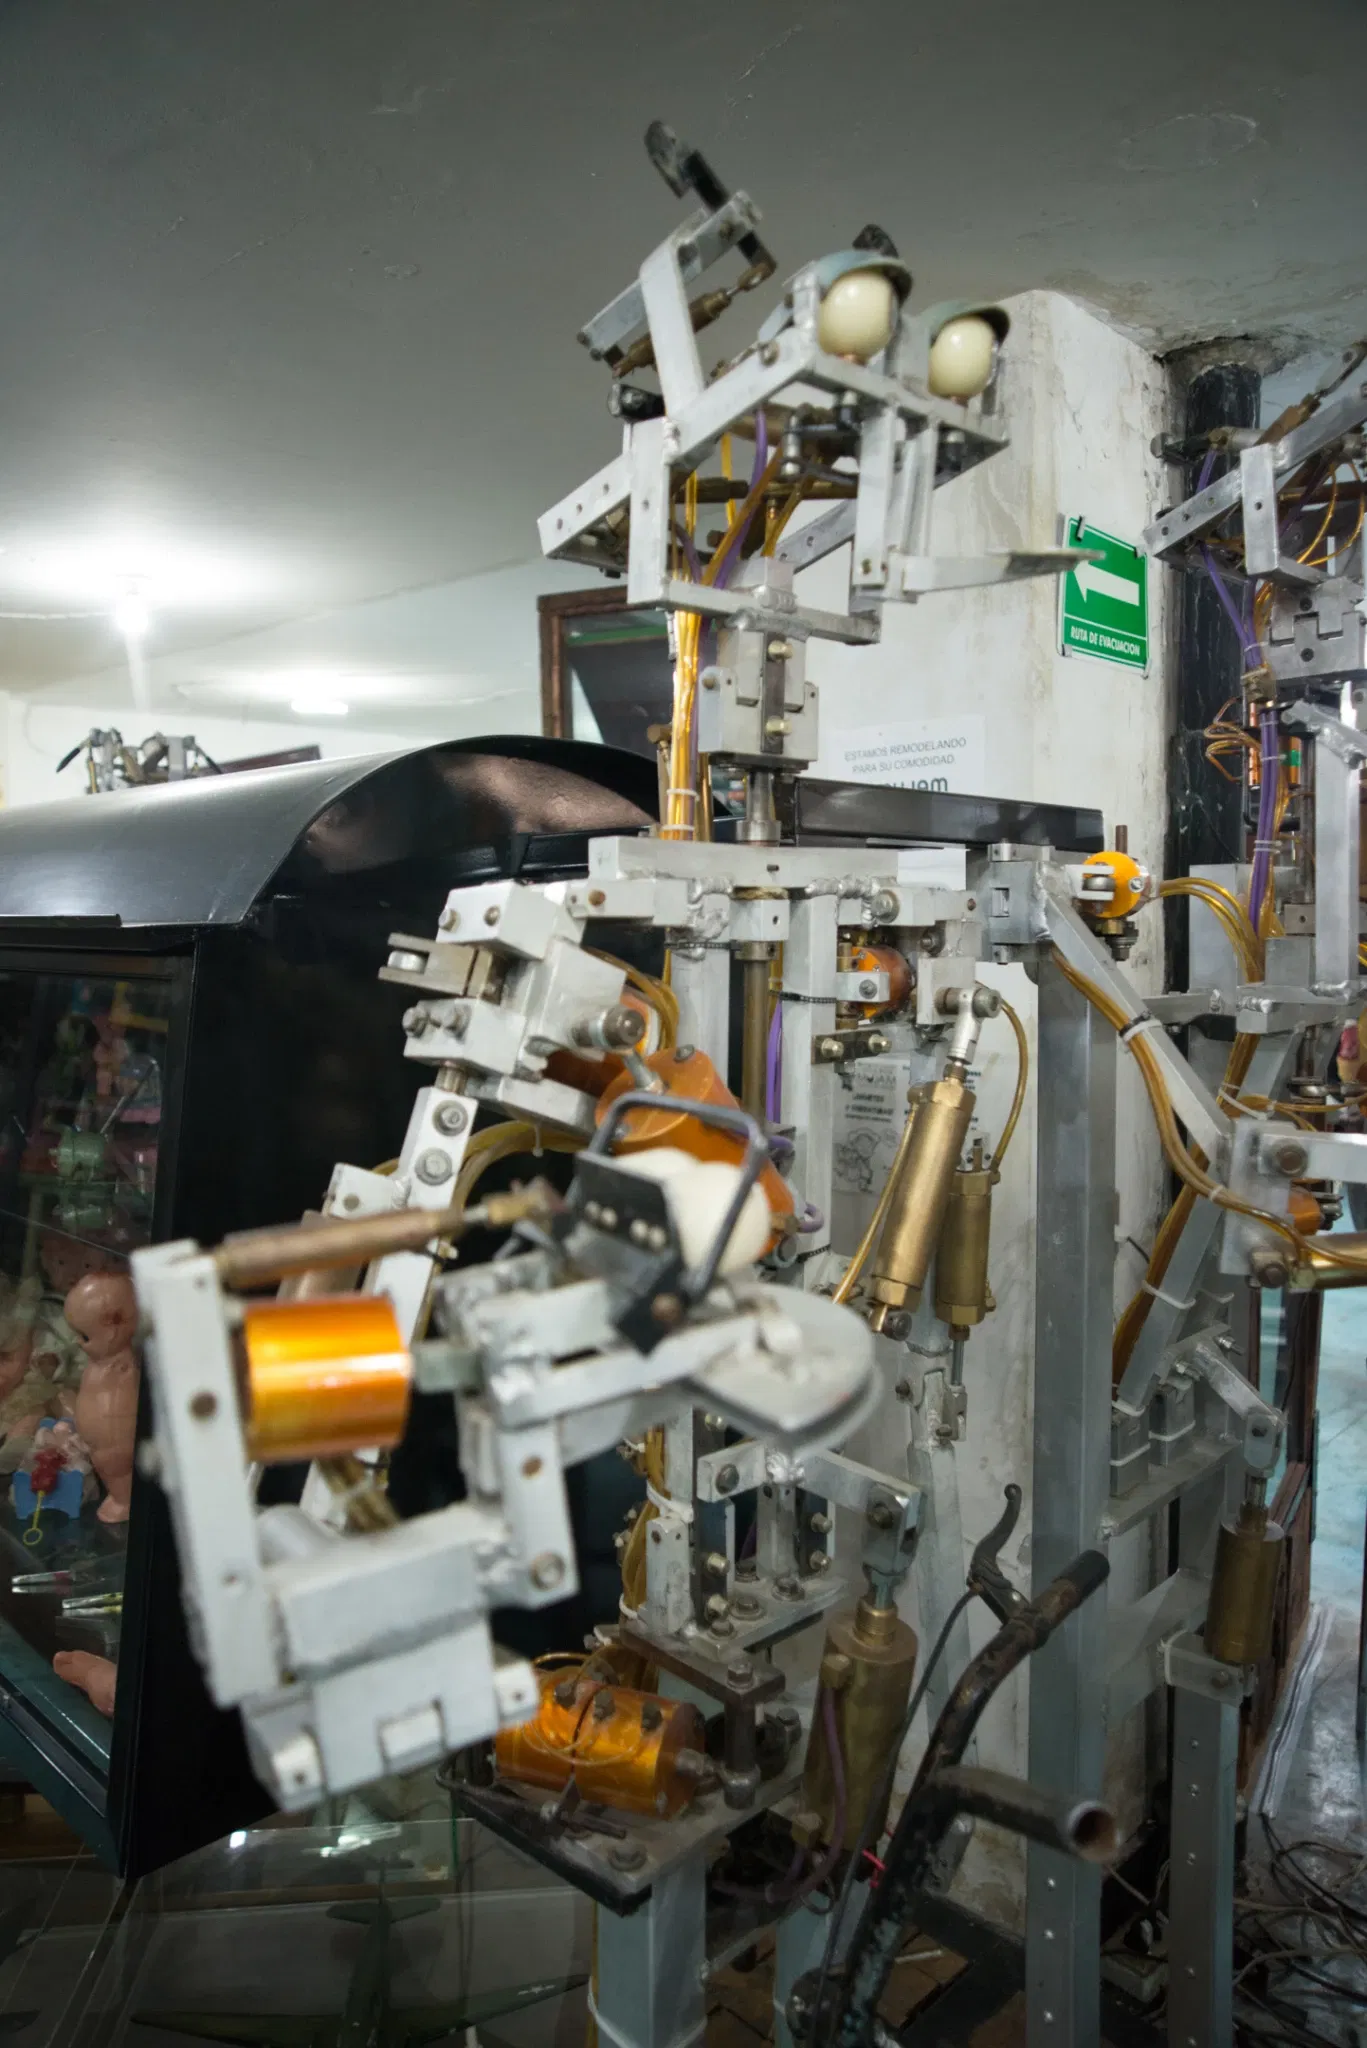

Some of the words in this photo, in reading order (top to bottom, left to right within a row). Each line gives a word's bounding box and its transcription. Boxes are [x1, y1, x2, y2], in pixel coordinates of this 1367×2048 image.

[1071, 626, 1088, 642] RUTA
[1089, 631, 1098, 645] DE
[844, 747, 888, 761] ESTAMOS
[890, 737, 967, 755] REMODELANDO
[852, 761, 877, 774] PARA
[879, 760, 892, 772] SU
